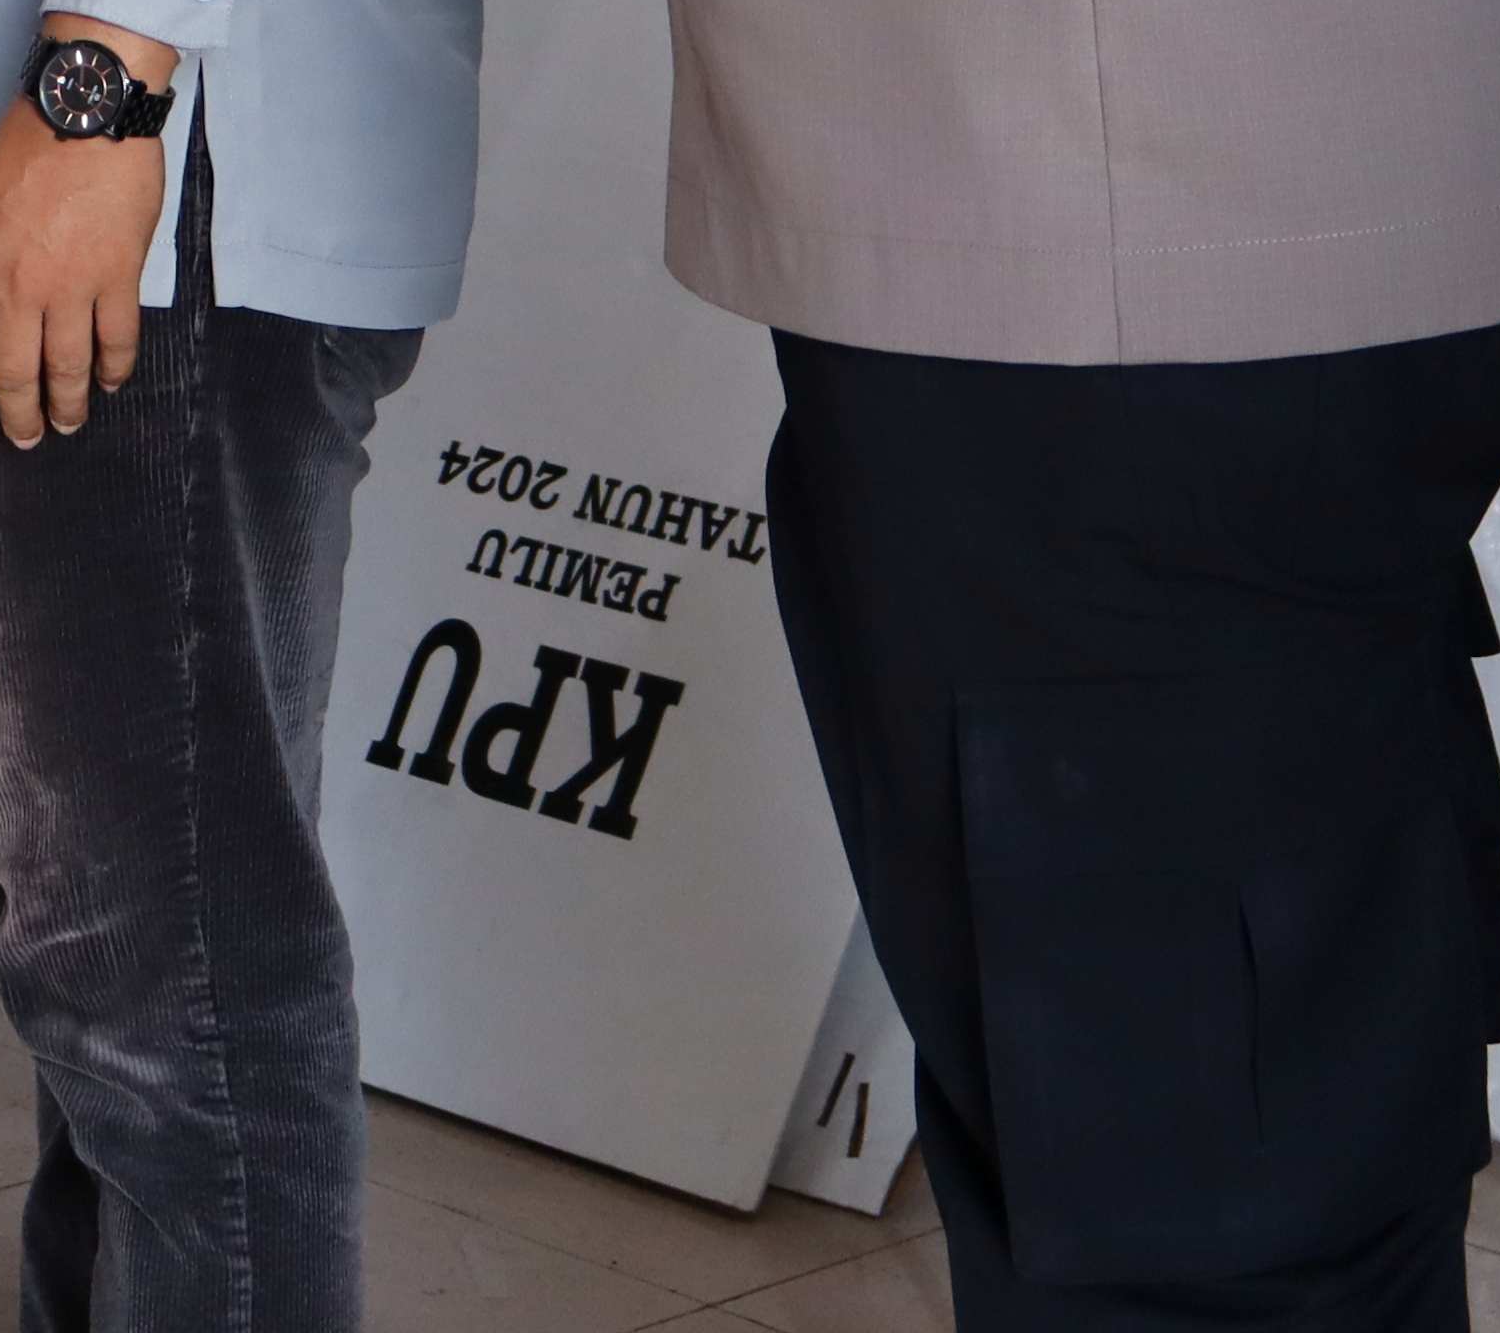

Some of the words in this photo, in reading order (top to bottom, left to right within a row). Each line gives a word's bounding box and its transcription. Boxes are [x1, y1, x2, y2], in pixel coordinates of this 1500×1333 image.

[437, 439, 568, 510] 2024
[574, 473, 768, 564] TAHUN
[466, 528, 682, 622] PEMILU
[365, 618, 686, 841] KPU
